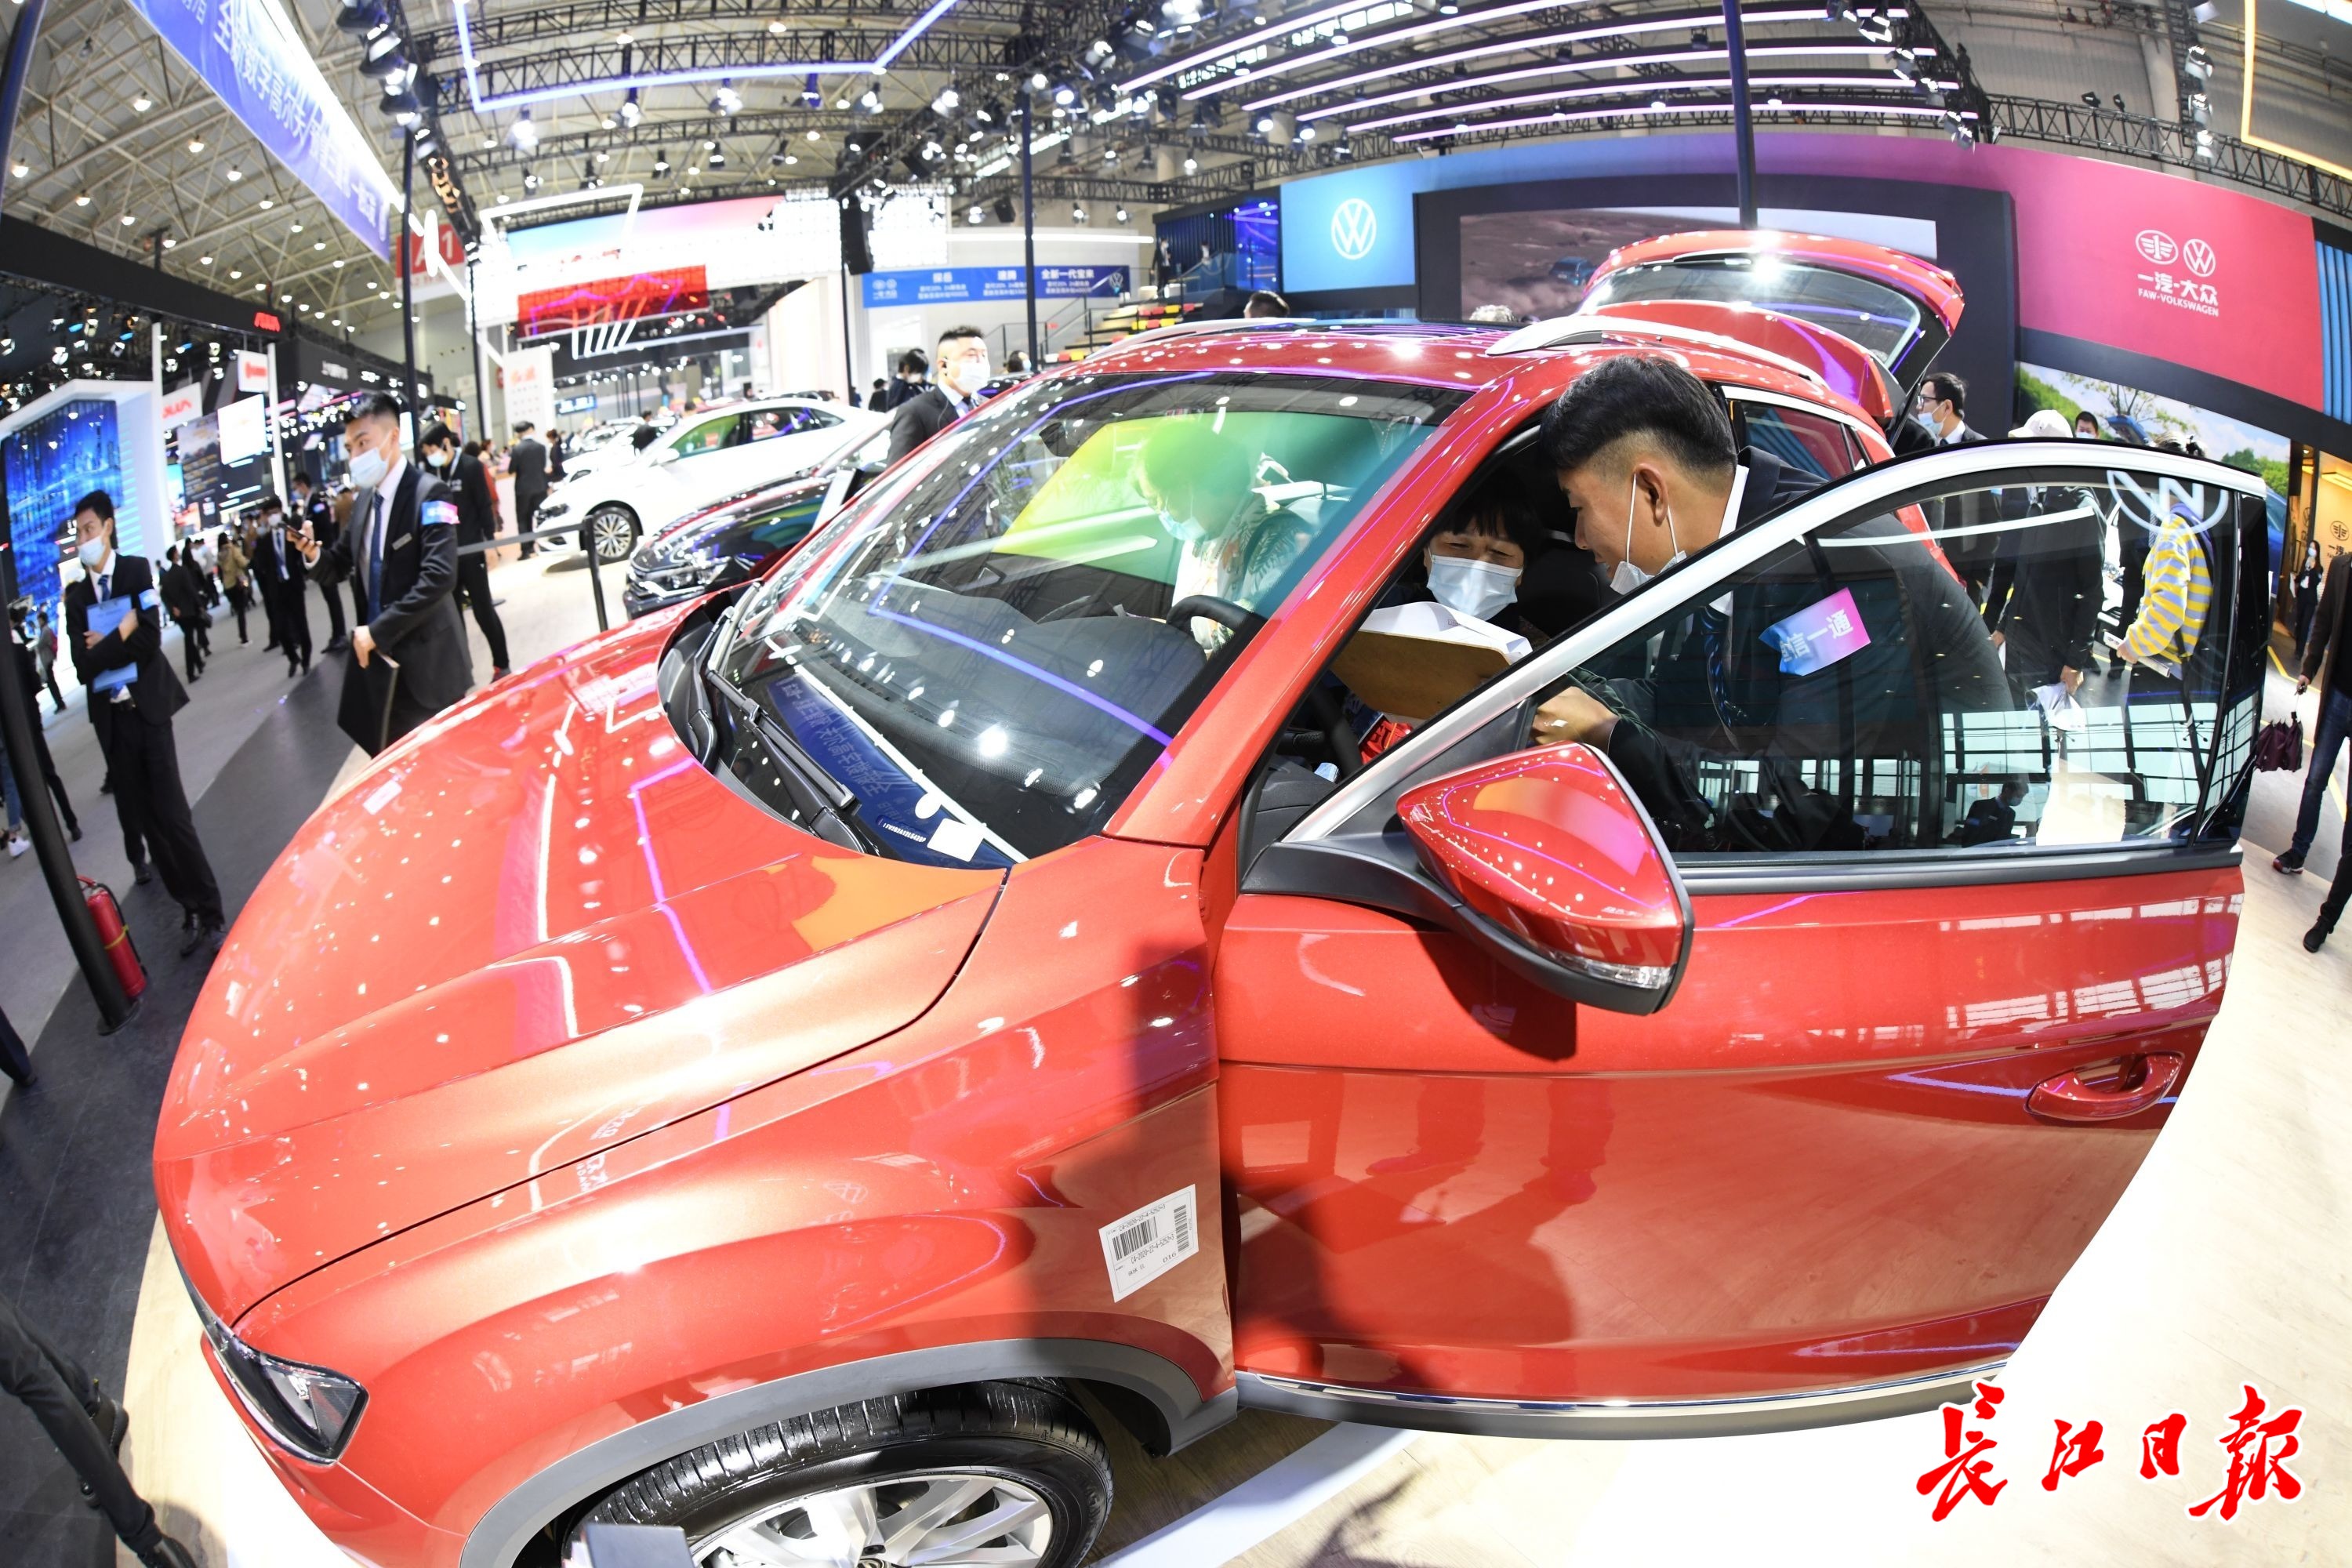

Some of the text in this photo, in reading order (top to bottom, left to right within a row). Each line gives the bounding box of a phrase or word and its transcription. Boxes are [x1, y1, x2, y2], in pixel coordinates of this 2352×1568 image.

[2137, 271, 2218, 306] 一汽-大众
[2138, 288, 2220, 317] FAW-VOLKSWAGEN
